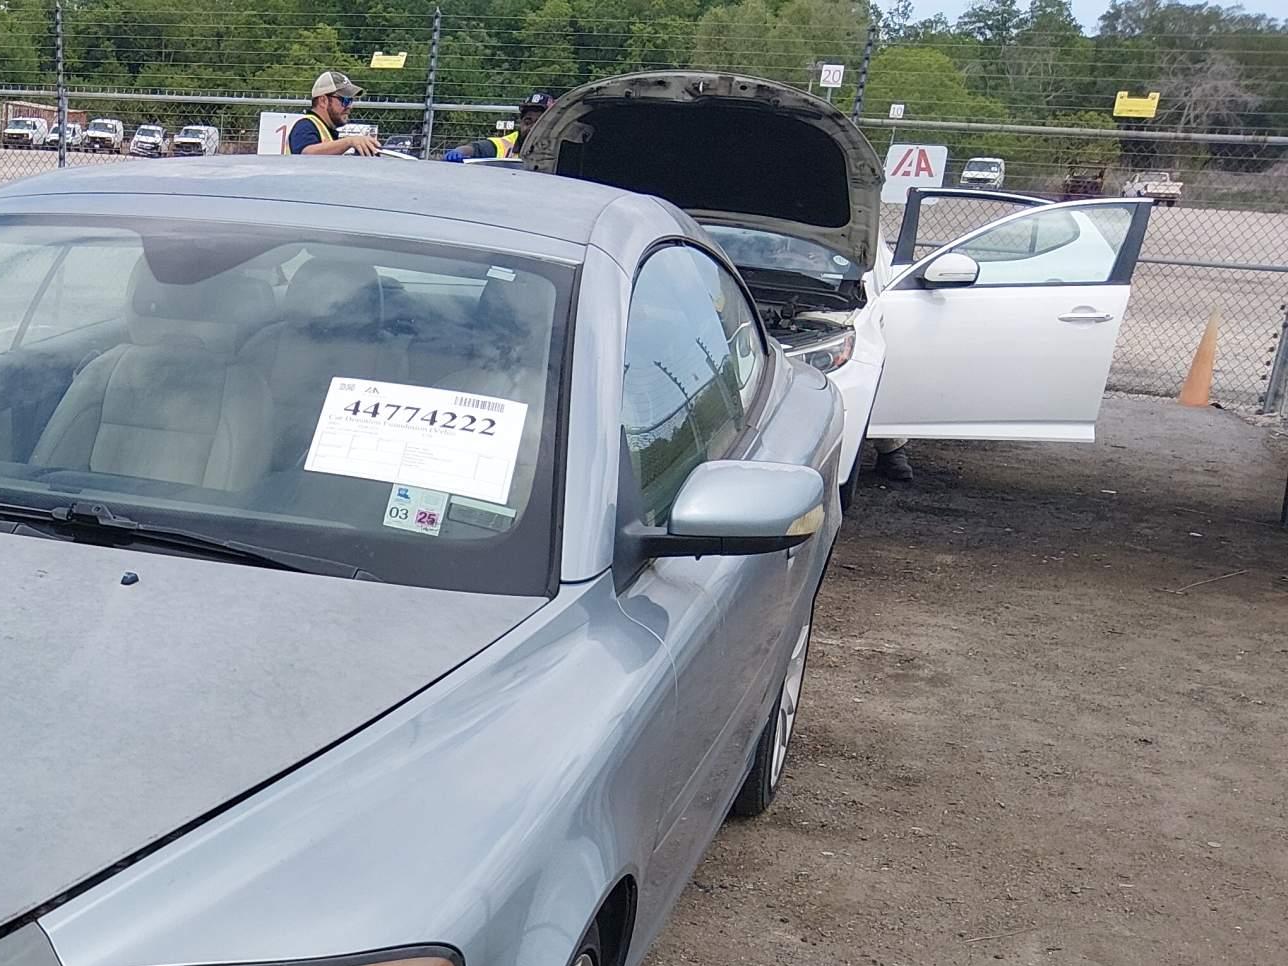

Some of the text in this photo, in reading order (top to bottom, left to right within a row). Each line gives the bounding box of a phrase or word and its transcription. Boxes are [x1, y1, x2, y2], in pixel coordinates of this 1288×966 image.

[822, 69, 842, 84] 20
[891, 106, 903, 116] 10
[275, 124, 287, 155] 1
[343, 399, 496, 436] 44774222
[389, 506, 409, 520] 03
[417, 511, 437, 526] 25
